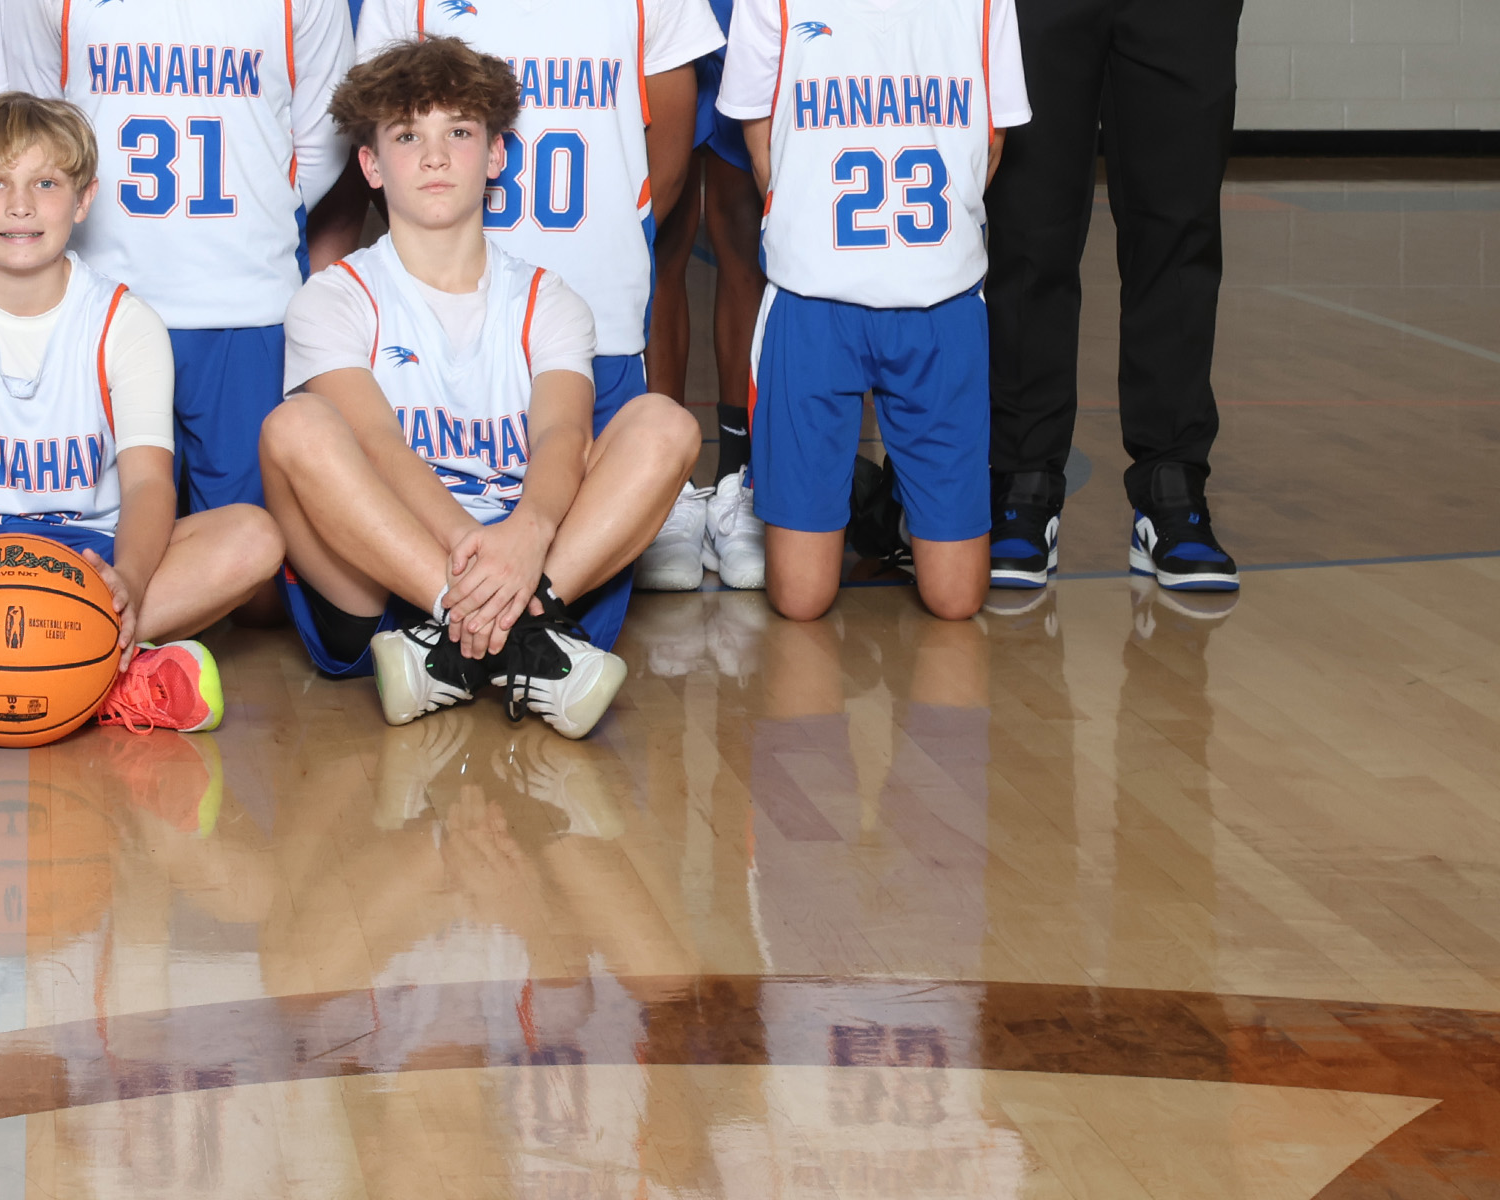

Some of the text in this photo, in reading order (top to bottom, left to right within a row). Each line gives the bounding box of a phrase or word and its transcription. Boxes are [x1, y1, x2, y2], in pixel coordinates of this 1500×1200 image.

[88, 42, 264, 98] HANAHAN
[504, 56, 622, 110] AHAN
[794, 75, 973, 131] HANAHAN
[117, 114, 238, 219] 31
[831, 144, 952, 251] 23
[17, 570, 39, 578] NXT
[29, 618, 62, 629] BASKETBALL
[45, 629, 66, 640] LEAGUE
